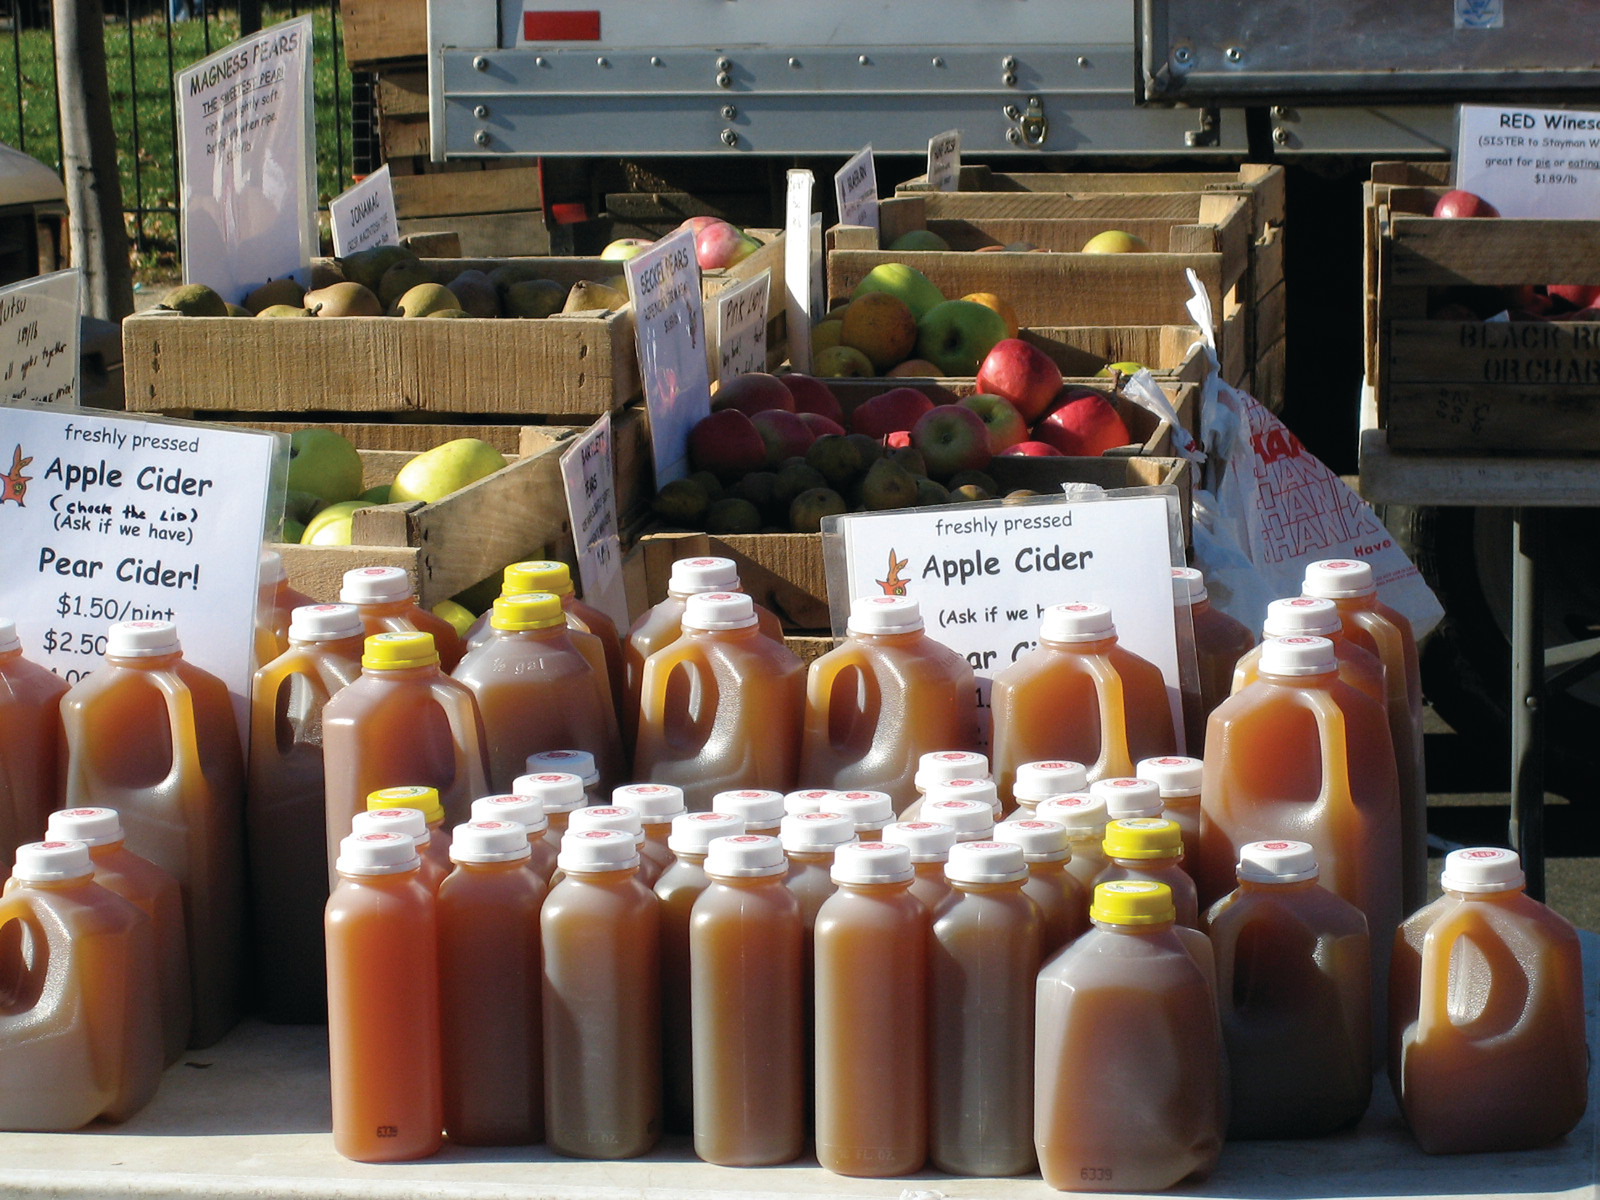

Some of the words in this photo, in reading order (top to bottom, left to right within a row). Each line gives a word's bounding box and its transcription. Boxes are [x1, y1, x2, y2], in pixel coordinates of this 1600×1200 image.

[190, 51, 248, 97] MAGNESS
[253, 32, 299, 66] PEARS
[202, 96, 218, 115] THE
[1500, 113, 1535, 129] RED
[1478, 135, 1524, 148] (SISTER
[1528, 137, 1539, 147] to
[1542, 136, 1585, 150] Stayman
[1485, 157, 1513, 168] great
[1516, 155, 1532, 167] for
[1535, 157, 1550, 169] pie
[1553, 158, 1565, 167] or
[1534, 173, 1578, 185] $1.89/lb
[350, 191, 380, 228] JONAMAC
[1459, 323, 1560, 349] BLACK
[65, 423, 128, 450] freshly
[132, 436, 200, 453] pressed
[44, 456, 123, 492] Apple
[136, 465, 213, 497] Cider
[122, 504, 146, 520] the
[935, 516, 998, 537] freshly
[1004, 511, 1073, 536] pressed
[54, 512, 91, 532] (Ask
[99, 518, 112, 534] if
[120, 524, 141, 537] we
[149, 523, 193, 546] have)
[1354, 539, 1392, 558] Have
[39, 547, 103, 578] Pear
[116, 556, 200, 590] Cider!
[922, 549, 1002, 586] Apple
[1014, 544, 1094, 574] Cider
[56, 592, 175, 622] $1.50/pint
[939, 607, 978, 629] (Ask
[984, 606, 998, 623] if
[1006, 609, 1029, 621] we
[1080, 1167, 1113, 1181] 6339
